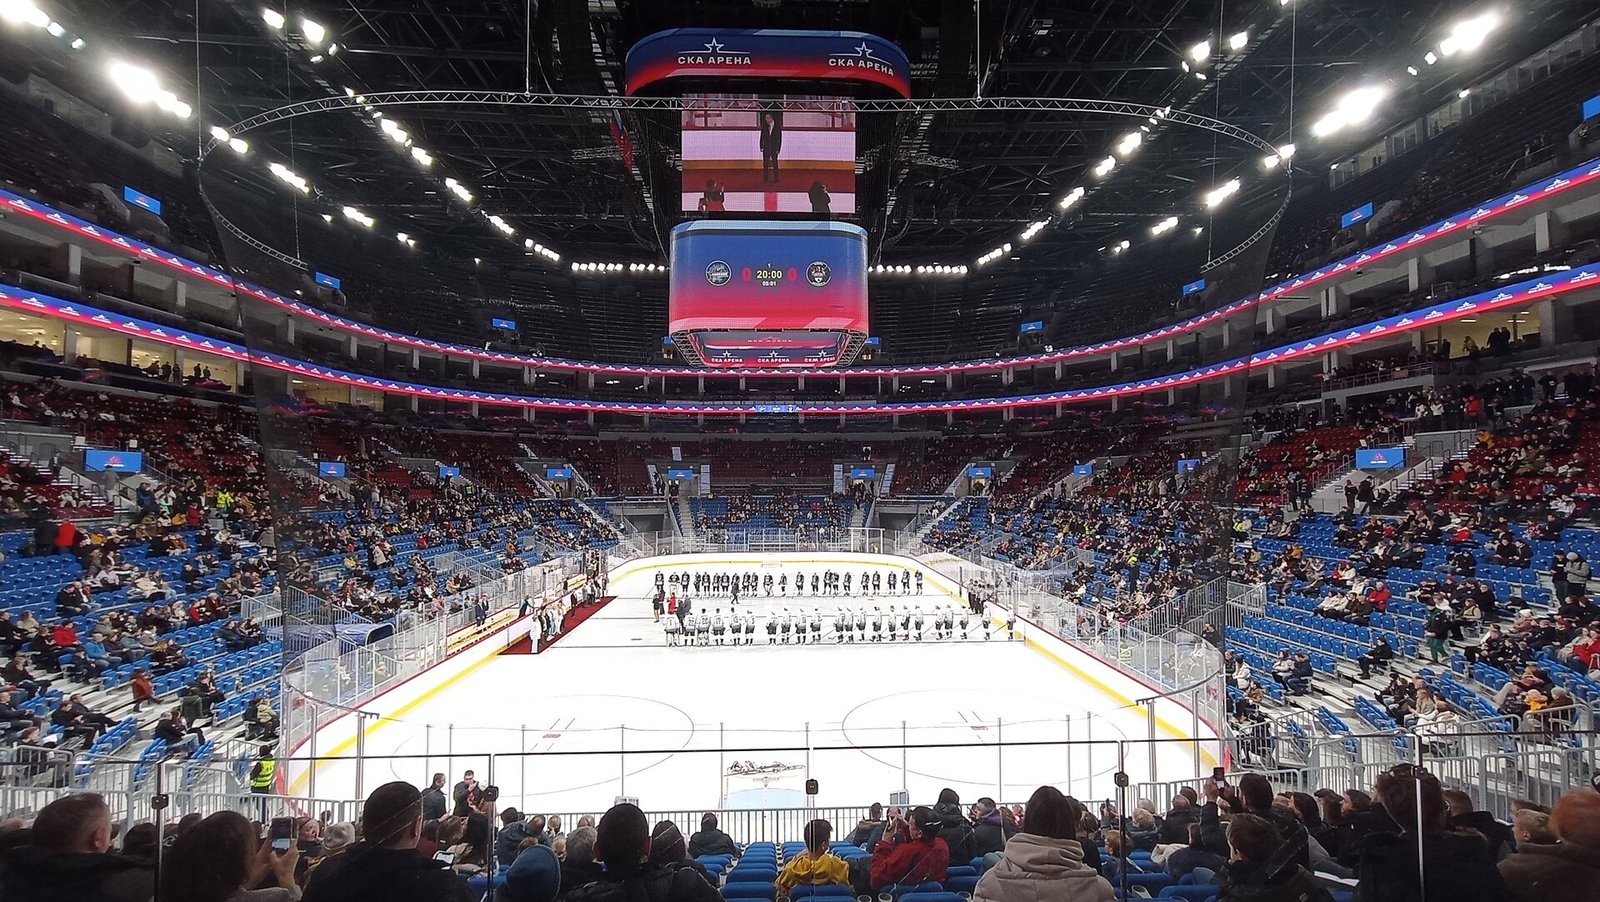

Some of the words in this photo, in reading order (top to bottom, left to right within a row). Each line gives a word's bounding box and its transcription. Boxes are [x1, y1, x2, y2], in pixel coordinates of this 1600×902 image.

[677, 56, 704, 66] СКА
[708, 56, 752, 66] АРЕНА
[828, 58, 855, 67] СКА
[858, 59, 895, 77] АРЕНА
[742, 267, 751, 282] 0
[756, 270, 783, 279] 20:00
